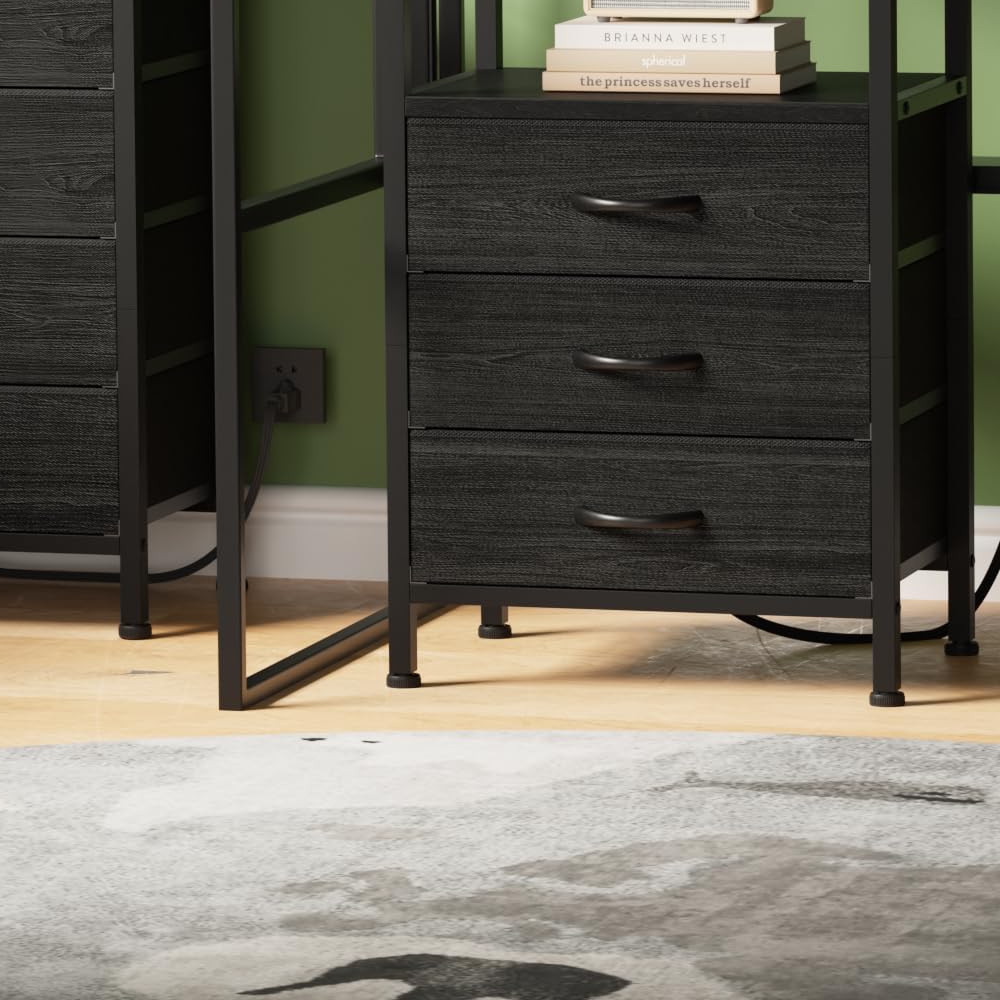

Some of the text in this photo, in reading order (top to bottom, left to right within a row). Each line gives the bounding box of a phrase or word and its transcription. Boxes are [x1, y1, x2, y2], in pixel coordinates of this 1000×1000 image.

[604, 32, 727, 44] BRIANNA WIEST
[640, 54, 687, 69] spherical
[580, 76, 751, 90] the princess saves herself
